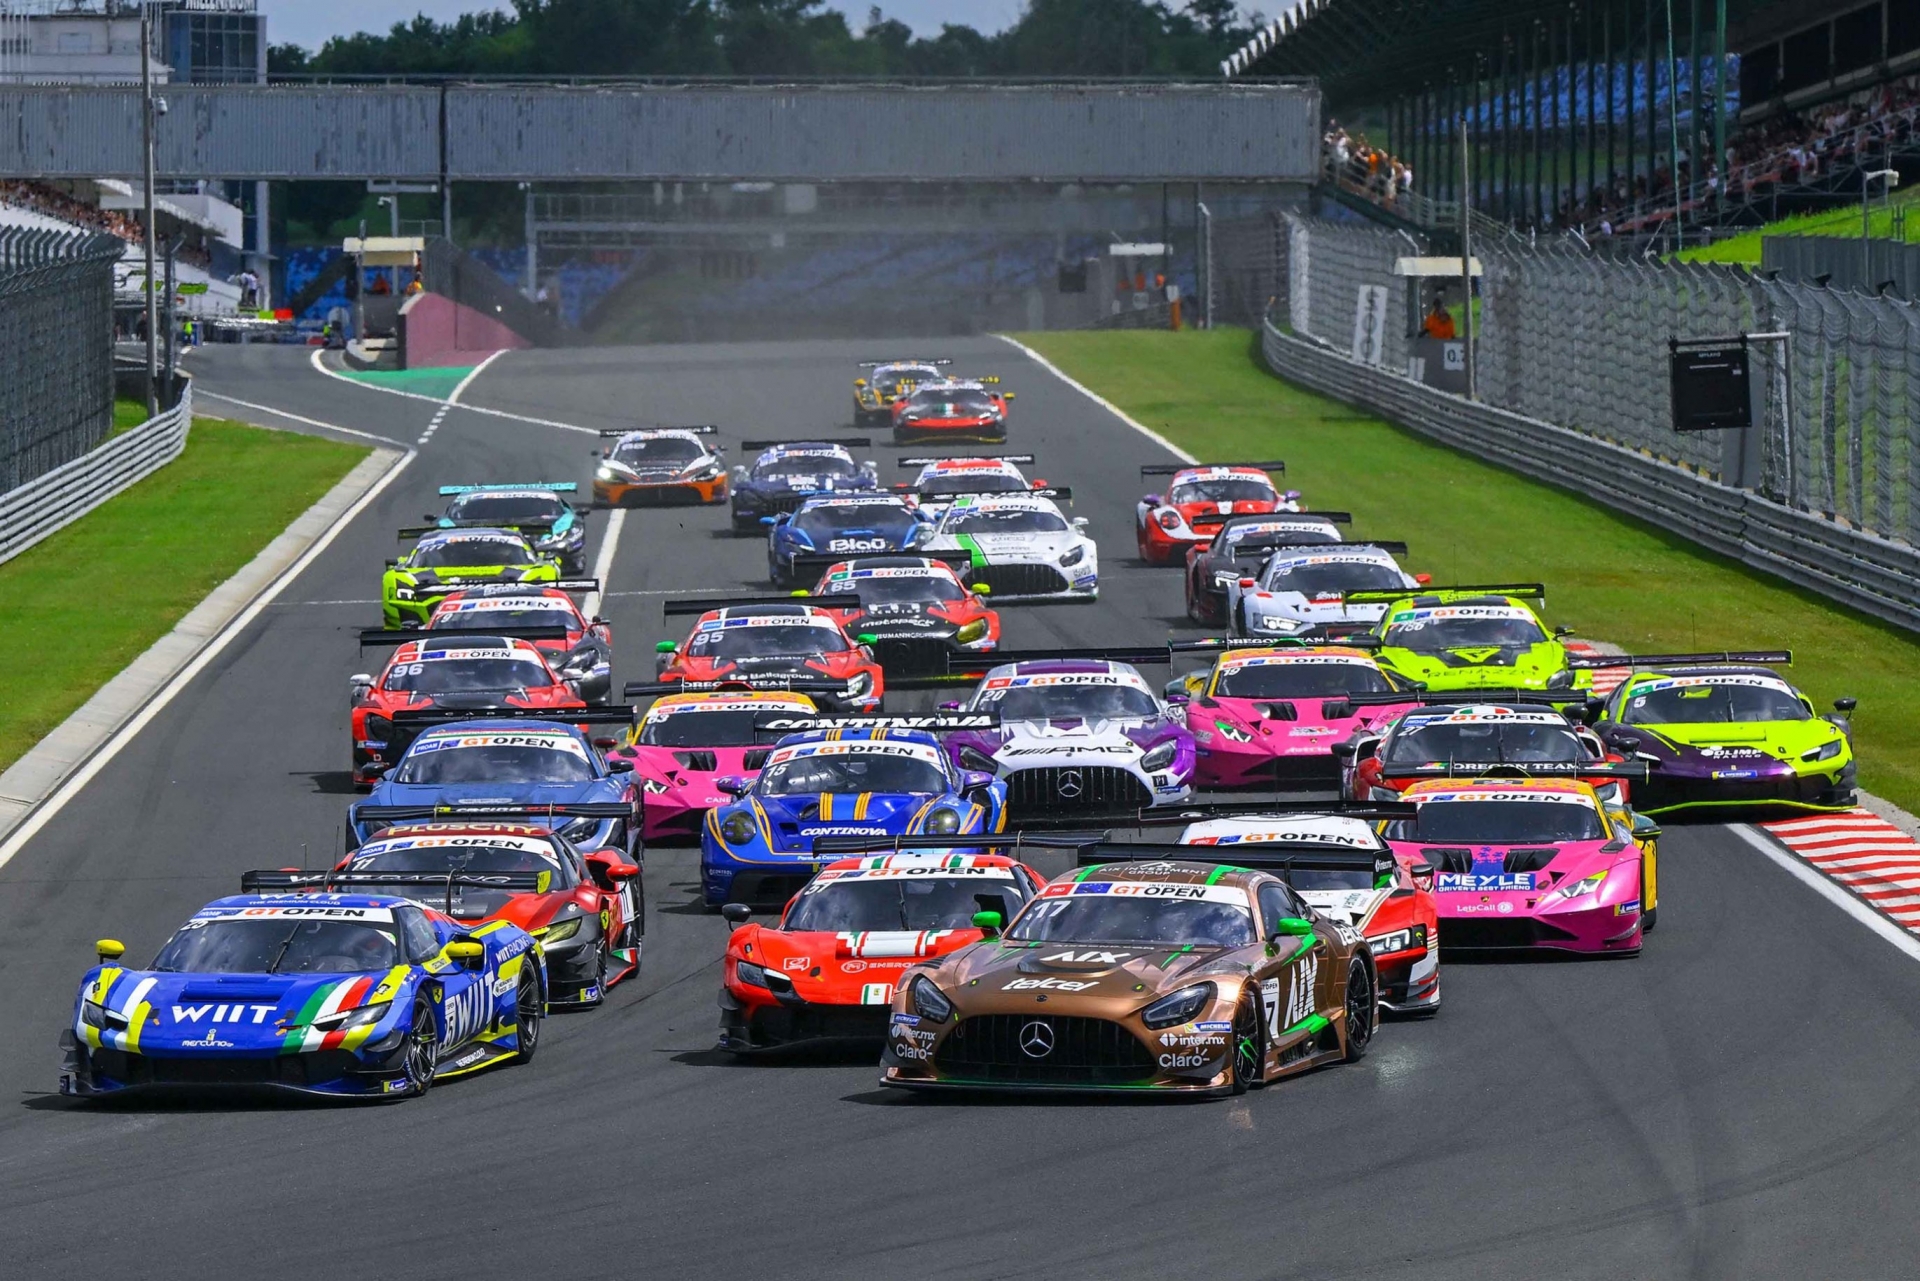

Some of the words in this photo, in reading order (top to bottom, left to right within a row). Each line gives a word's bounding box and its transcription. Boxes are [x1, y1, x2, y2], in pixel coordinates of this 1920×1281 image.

[479, 599, 549, 609] GTOPEN
[1434, 608, 1509, 617] GTOPEN
[750, 618, 810, 627] GTOPEN
[694, 632, 724, 646] 95
[448, 650, 511, 659] GTOPEN
[1268, 657, 1350, 665] GTOPEN
[393, 663, 424, 677] 96
[1032, 676, 1117, 685] GTOPEN
[1677, 677, 1762, 686] GTOPEN
[983, 690, 1006, 701] 20
[699, 703, 786, 711] GTOPEN
[1633, 697, 1646, 708] 5
[765, 716, 992, 730] CONTINOVA
[1451, 714, 1545, 723] GTOPEN
[416, 743, 437, 752] PROAM
[463, 737, 555, 748] GTOPEN
[820, 745, 914, 757] GTOPEN
[767, 764, 789, 777] 15
[1458, 793, 1562, 803] GTOPEN
[387, 823, 540, 836] PLUSCITY
[799, 827, 888, 836] CONTINOVA
[416, 838, 524, 850] GTOPEN
[1244, 833, 1355, 846] GTOPEN
[359, 846, 385, 857] PROAM
[868, 868, 986, 878] GTOPEN
[1438, 872, 1532, 886] MEYLE
[1113, 886, 1206, 899] GTOPEN
[1438, 885, 1475, 893] DRIVER'S
[244, 908, 366, 918] GTOPEN
[1033, 900, 1072, 919] 17
[1456, 903, 1496, 912] LetsCall
[1002, 977, 1101, 992] telcel
[172, 1004, 278, 1023] WIIT
[1200, 1022, 1231, 1031] MICHELIN
[1179, 1034, 1226, 1046] inter.mx
[896, 1043, 928, 1060] Claro
[1159, 1052, 1203, 1067] Claro
